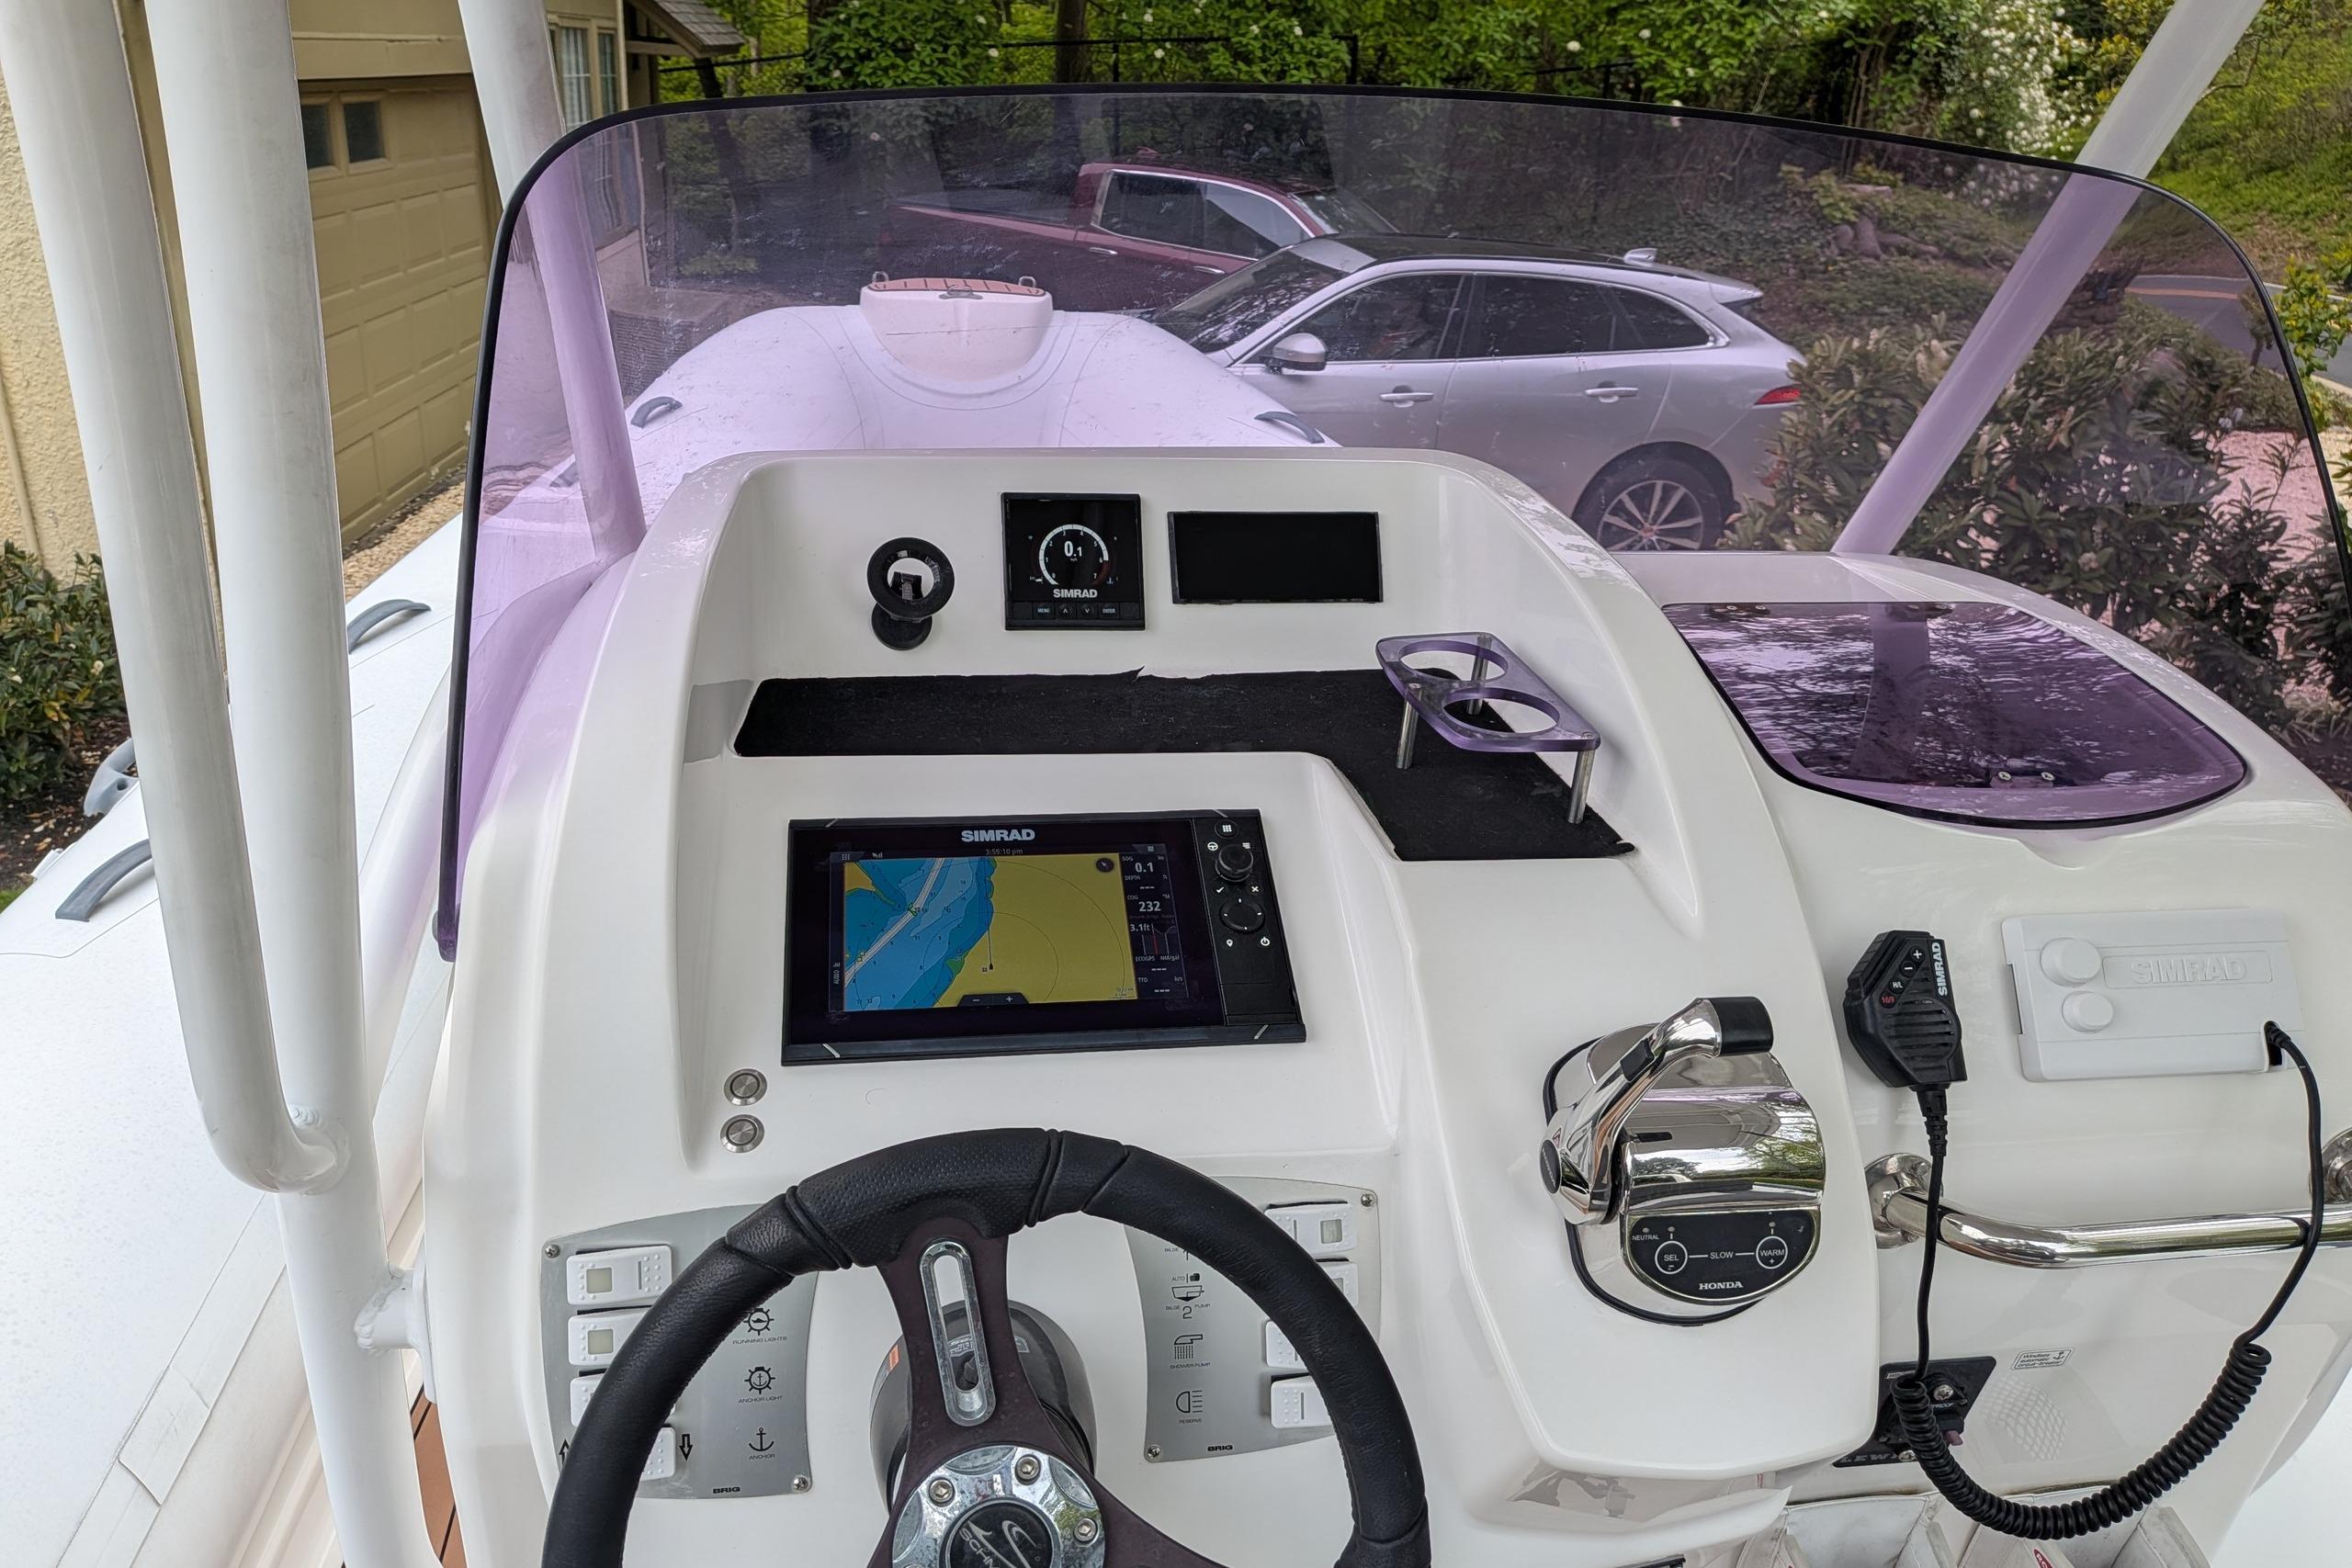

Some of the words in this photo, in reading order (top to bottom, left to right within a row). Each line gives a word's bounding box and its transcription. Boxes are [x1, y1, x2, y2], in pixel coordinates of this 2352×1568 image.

[1064, 540, 1082, 557] 0.1
[1053, 589, 1098, 598] SIMRAD
[961, 829, 1035, 842] SIMRAD
[985, 848, 1011, 856] 3:59:10
[1012, 848, 1023, 856] pm
[1135, 862, 1154, 873] 0.1
[1138, 900, 1161, 912] 232
[1931, 942, 1948, 997] SIMRAD
[2131, 956, 2247, 984] SIMRAD
[1663, 1254, 1679, 1262] SEL
[1710, 1251, 1734, 1259] SLOW
[1699, 1280, 1744, 1291] HONDA
[1182, 1305, 1193, 1319] 2
